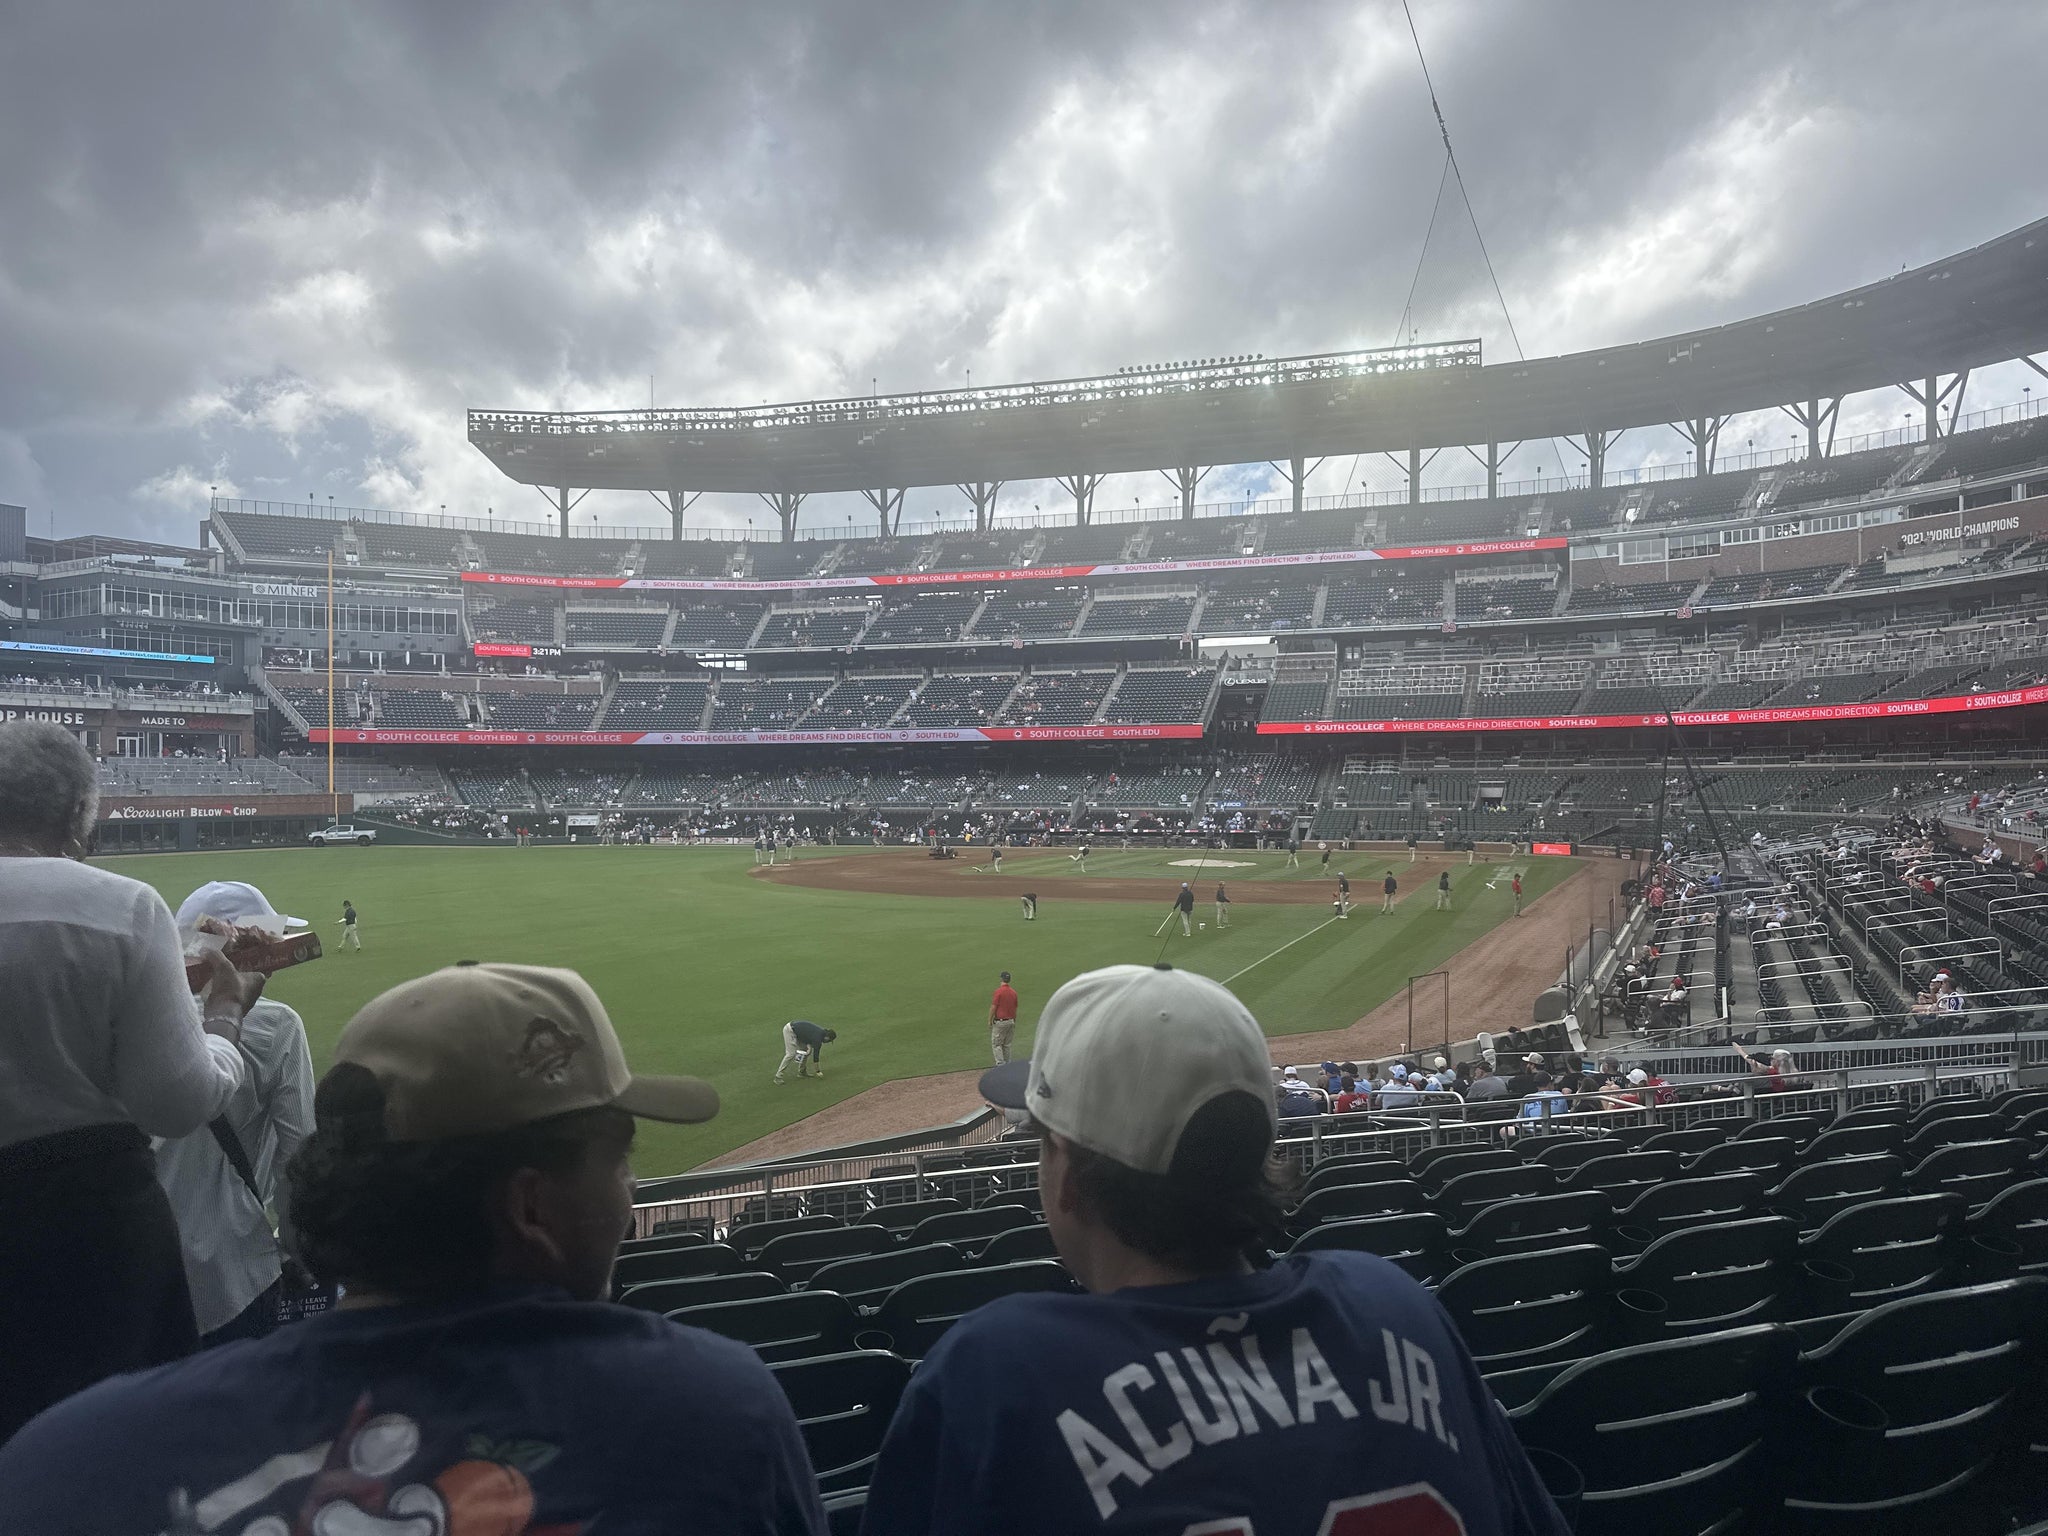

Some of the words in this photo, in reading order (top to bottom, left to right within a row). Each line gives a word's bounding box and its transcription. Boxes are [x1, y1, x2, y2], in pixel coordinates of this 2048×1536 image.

[1901, 532, 1923, 545] 2021
[1927, 526, 1962, 541] WORLD
[1963, 516, 2019, 537] CHAMPIONS
[1410, 547, 1449, 555] SOUTH.EDU
[1471, 544, 1499, 552] SOUTH
[1500, 541, 1536, 550] COLLEGE
[1212, 559, 1242, 567] DREAMS
[1261, 556, 1299, 564] DIRECTION
[1320, 553, 1356, 561] SOUTH.EDU
[908, 575, 928, 583] SOUTH
[929, 574, 957, 582] COLLEGE
[962, 572, 994, 580] SOUTH.EDU
[1011, 570, 1033, 578] SOUTH
[1034, 568, 1063, 577] COLLEGE
[501, 575, 524, 584] SOUTH
[525, 577, 557, 586] COLLEGE
[562, 579, 597, 587] SOUTH.EDU
[533, 648, 549, 656] 3:21
[549, 648, 561, 656] PM
[1974, 695, 1996, 706] SOUTH
[1997, 692, 2022, 705] COLLEGE
[2025, 689, 2043, 701] WHERE
[25, 711, 84, 725] HOUSE
[1688, 713, 1730, 723] COLLEGE
[1737, 710, 1771, 720] WHERE
[1772, 708, 1810, 719] DREAMS
[1811, 707, 1834, 717] FIND
[1835, 706, 1880, 717] DIRECTION
[1887, 703, 1928, 713] SOUTH.EDU
[141, 716, 170, 726] MADE
[172, 717, 185, 726] TO
[1315, 723, 1345, 731] SOUTH
[1346, 723, 1385, 731] COLLEGE
[1392, 722, 1424, 730] WHERE
[1427, 721, 1465, 730] DREAMS
[1467, 720, 1488, 729] FIND
[1490, 719, 1541, 729] DIRECTION
[1548, 718, 1597, 727] SOUTH.EDU
[376, 733, 412, 741] SOUTH
[414, 733, 460, 742] COLLEGE
[467, 734, 518, 742] SOUTH.EDU
[545, 734, 578, 743] SOUTH
[580, 734, 622, 743] COLLEGE
[680, 734, 711, 742] SOUTH
[712, 734, 748, 742] COLLEGE
[757, 733, 788, 741] WHERE
[789, 733, 824, 741] DREAMS
[847, 732, 892, 741] DIRECTION
[915, 731, 959, 739] SOUTH.EDU
[1030, 730, 1061, 738] SOUTH
[1063, 729, 1105, 738] COLLEGE
[1112, 728, 1160, 736] SOUTH.EDU
[123, 806, 156, 818] Coors
[156, 808, 185, 818] LIGHT
[190, 807, 222, 817] BELOW
[233, 807, 257, 816] CHOP
[1056, 1311, 1358, 1520] ACUÑA
[1369, 1328, 1459, 1452] JR.
